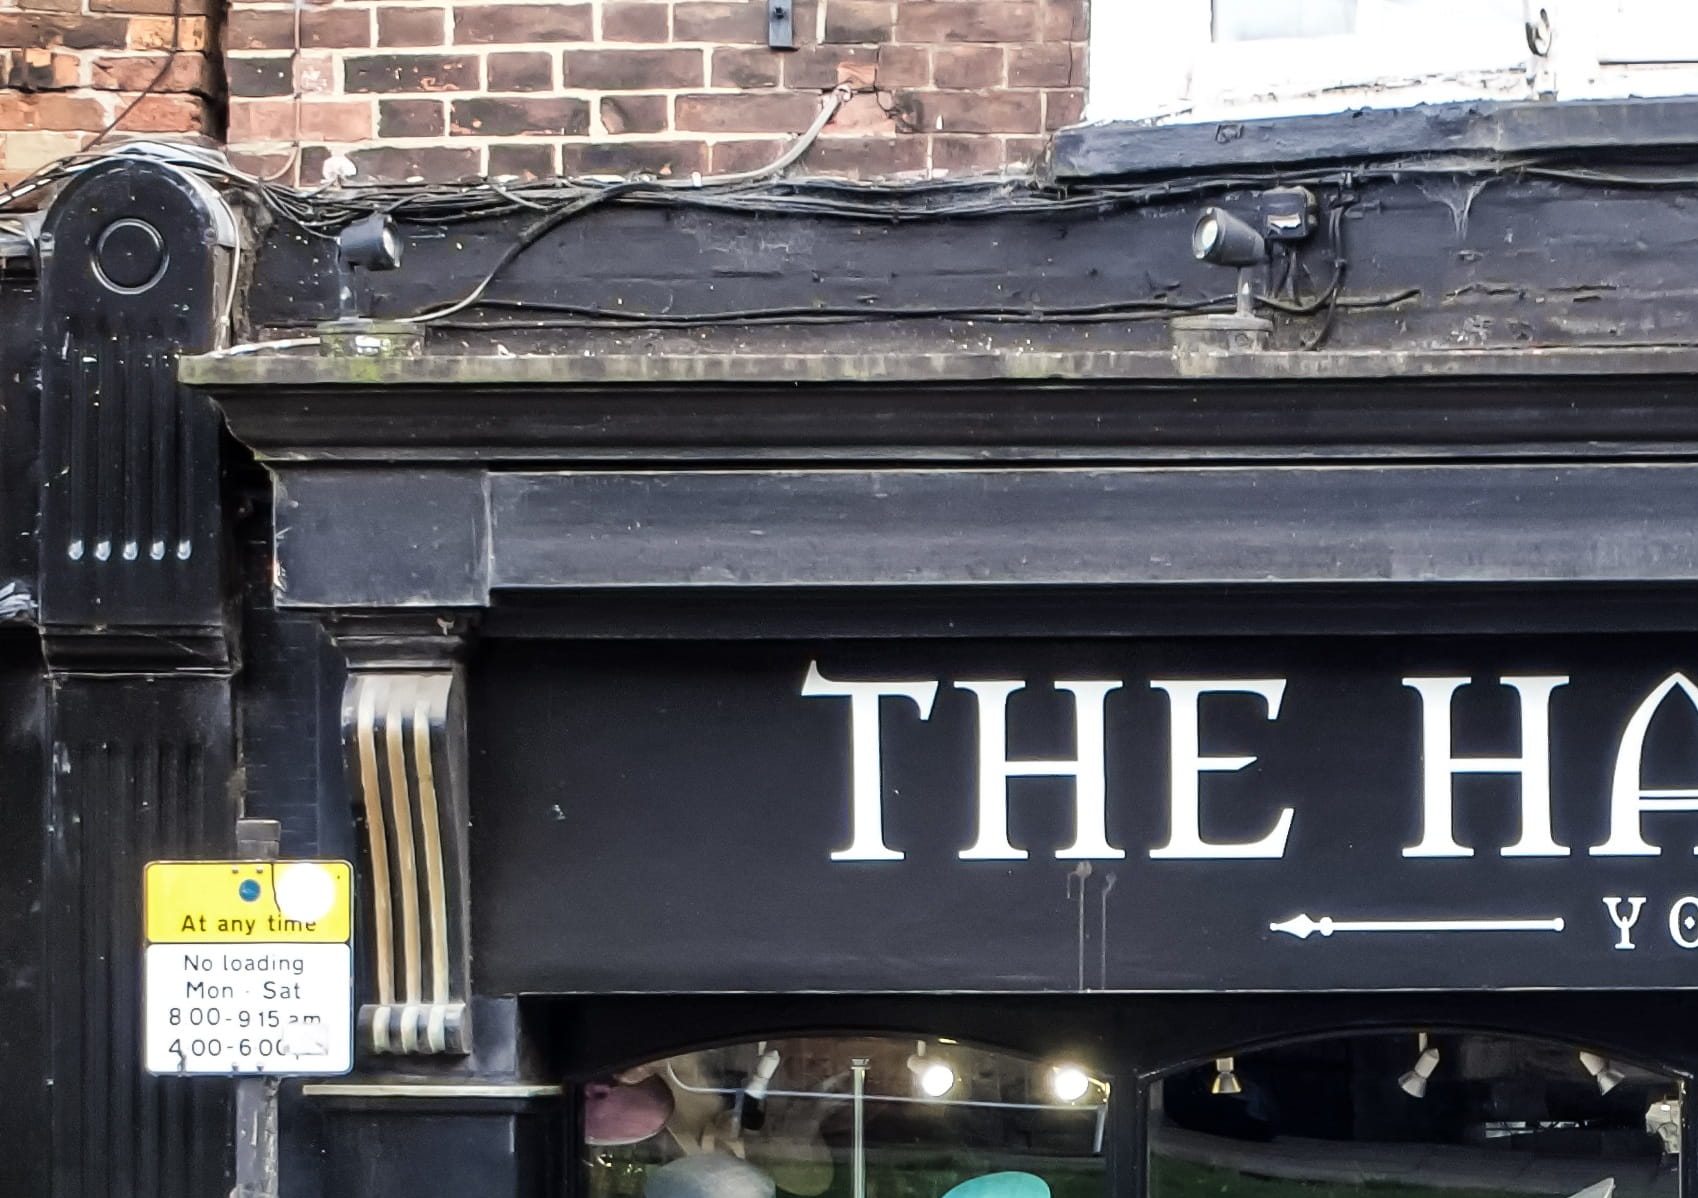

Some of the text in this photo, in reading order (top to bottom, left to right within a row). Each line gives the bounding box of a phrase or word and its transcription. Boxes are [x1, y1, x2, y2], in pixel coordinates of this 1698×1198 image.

[801, 661, 1294, 860] THE
[181, 914, 317, 935] At any time
[184, 954, 304, 976] No loading
[186, 980, 301, 1000] Mon Sat
